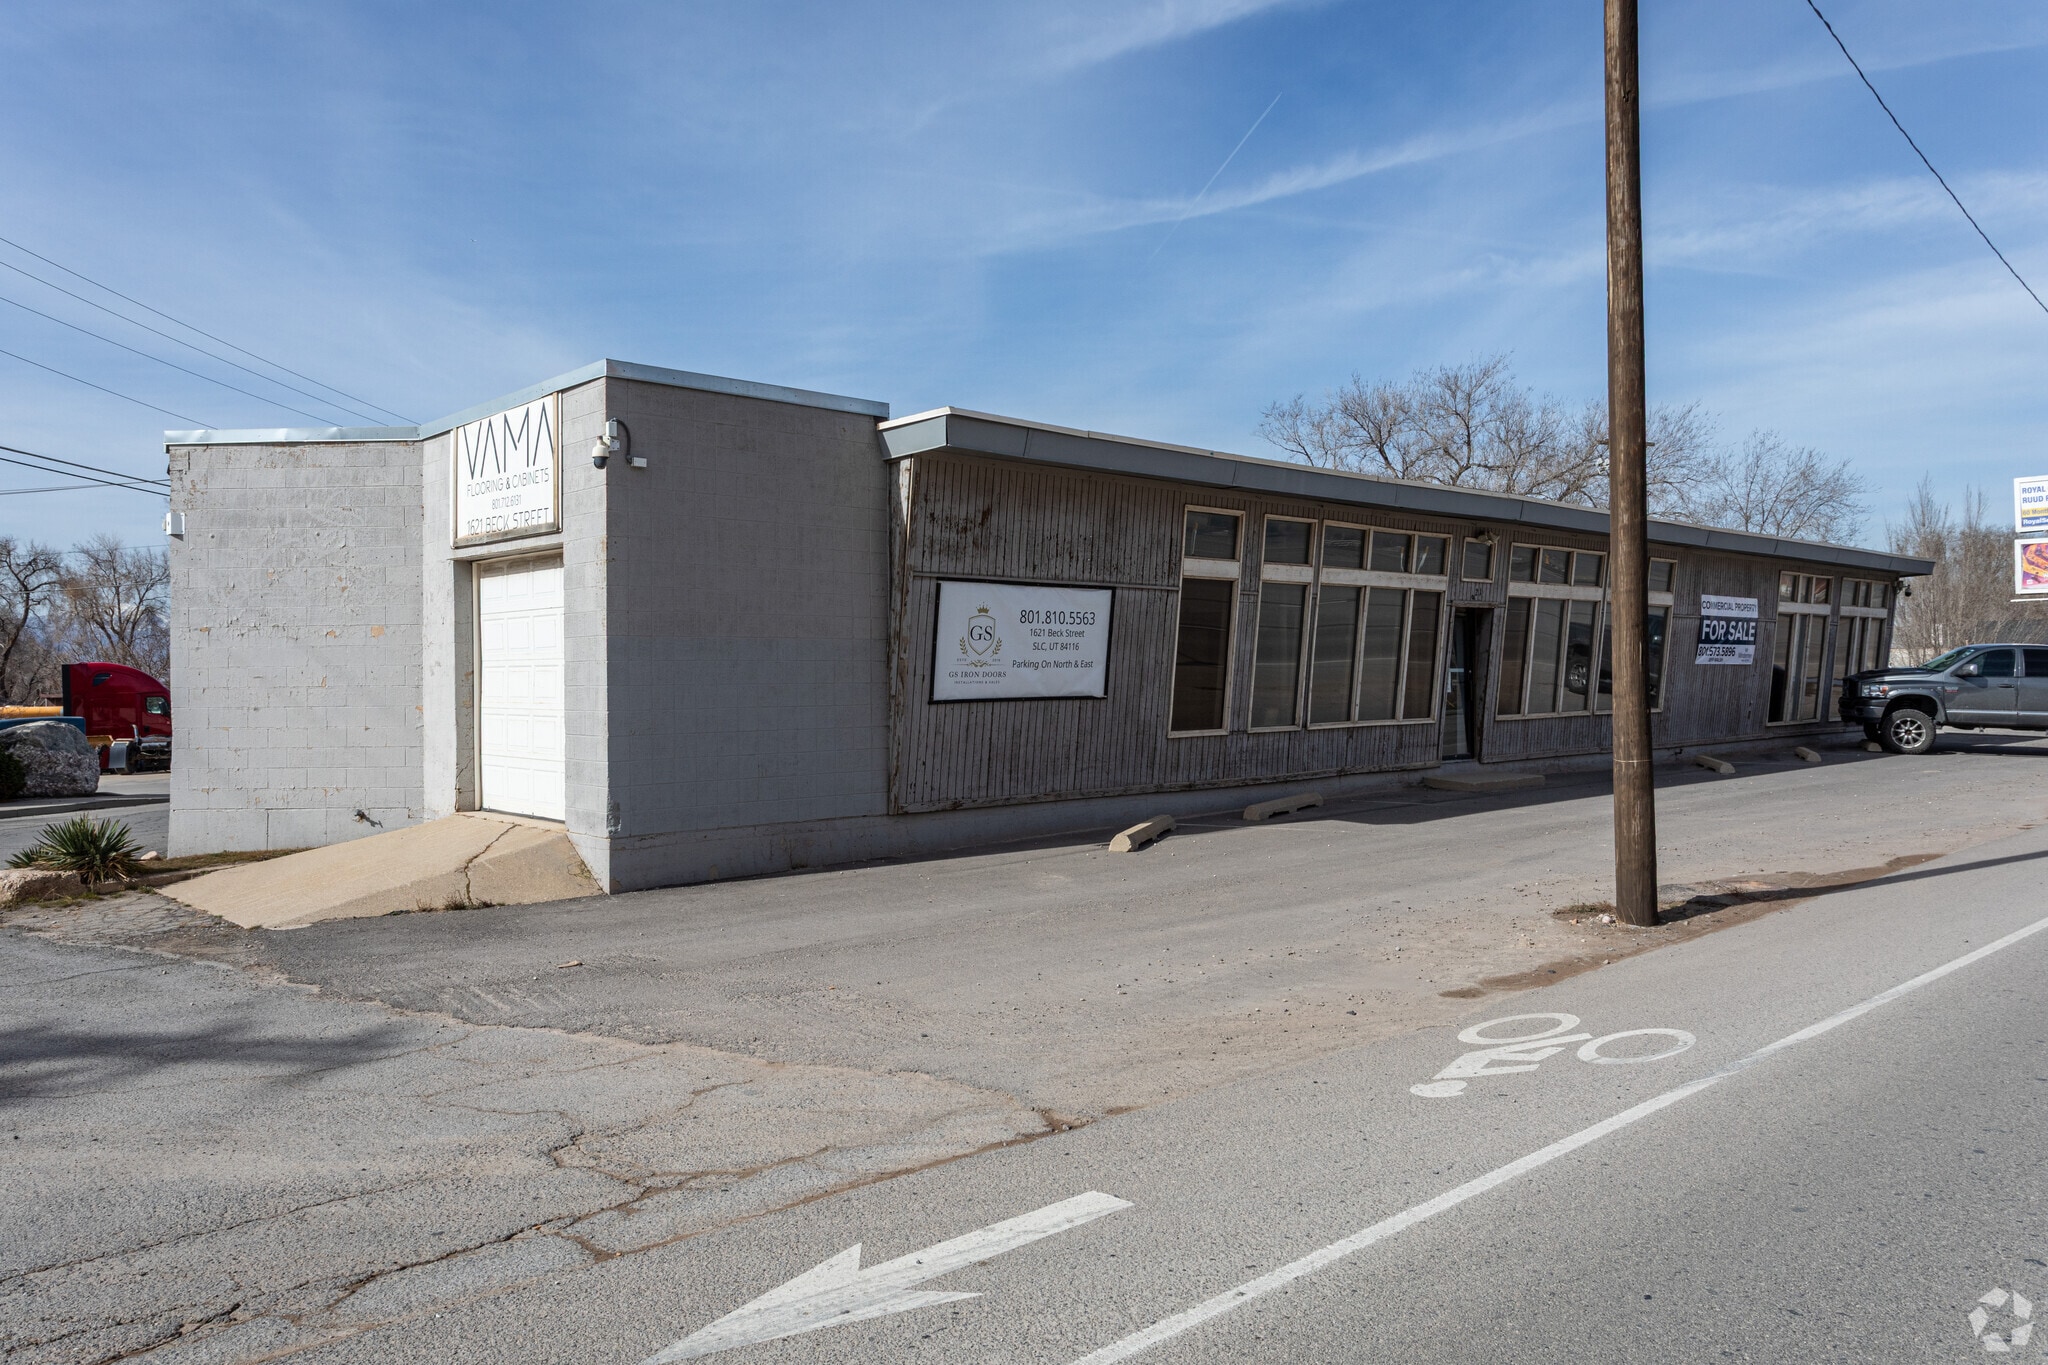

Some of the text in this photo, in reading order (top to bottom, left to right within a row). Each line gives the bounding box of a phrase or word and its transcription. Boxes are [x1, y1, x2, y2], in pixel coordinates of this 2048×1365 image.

[462, 401, 554, 480] VAMA
[467, 467, 550, 497] FLOORING & CABINETS
[2022, 486, 2046, 494] ROYAL
[467, 507, 550, 536] 1621 BECK STREET
[1701, 600, 1734, 611] COMMERCIAL
[1019, 609, 1096, 626] 801.810.5563
[970, 625, 993, 641] GS
[1030, 628, 1085, 638] 1621 Beck Street
[1701, 620, 1756, 641] FOR SALE
[1032, 642, 1080, 652] SLC, UT 84116
[1012, 659, 1094, 671] Parking On North & East
